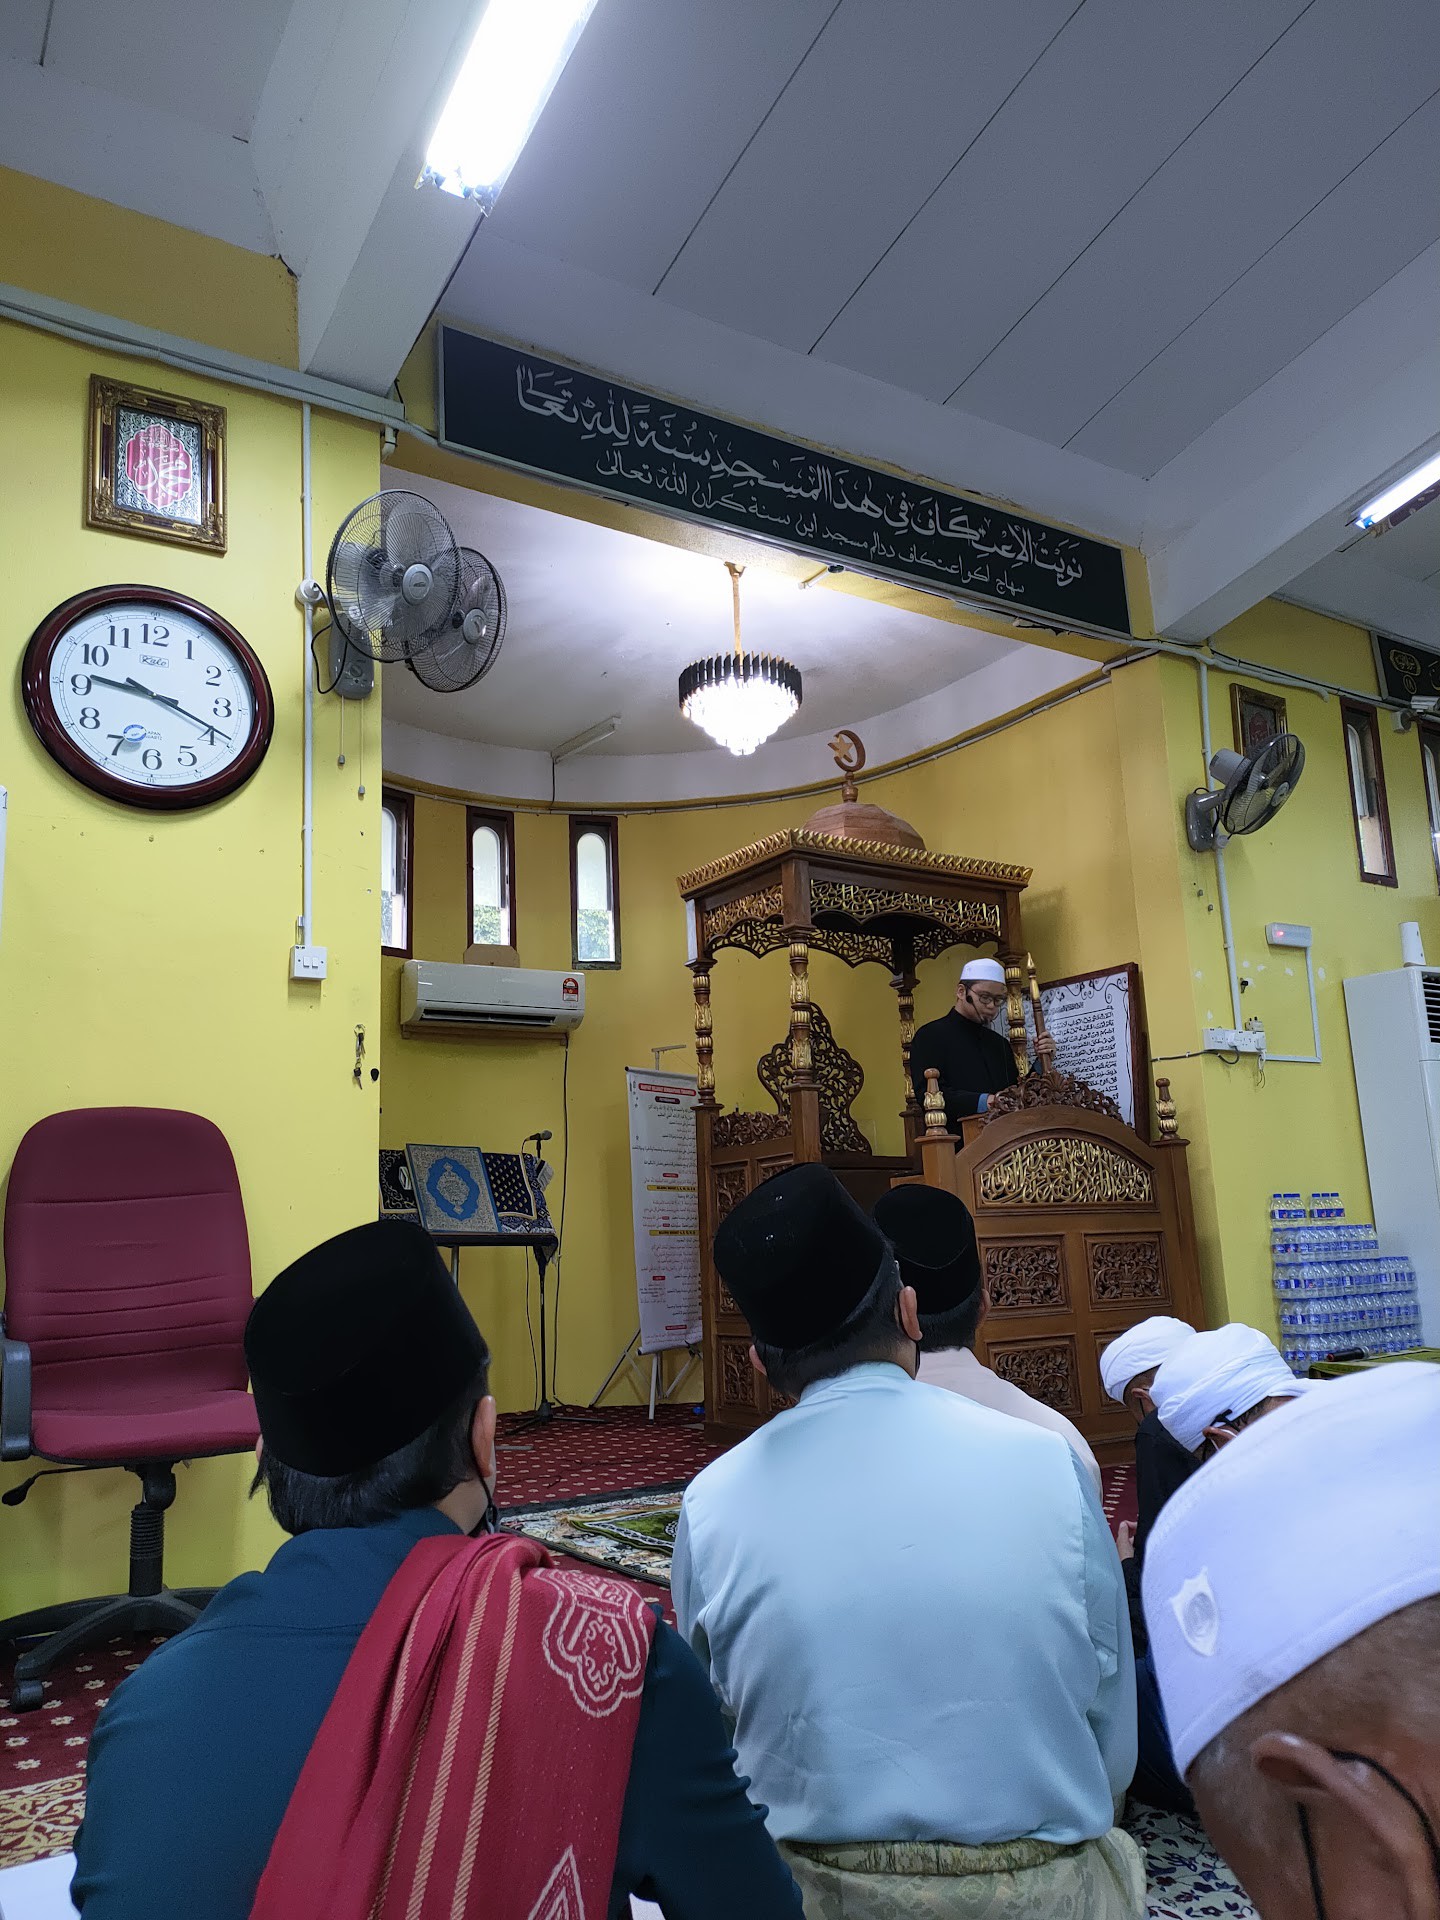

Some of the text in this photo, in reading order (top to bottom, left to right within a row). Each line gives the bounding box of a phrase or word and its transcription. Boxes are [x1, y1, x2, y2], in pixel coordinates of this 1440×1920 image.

[821, 526, 868, 549] مسجد
[106, 625, 132, 650] 11
[139, 623, 170, 648] 12
[80, 643, 110, 668] 10
[184, 639, 195, 661] 1
[70, 673, 92, 696] 9
[205, 665, 222, 687] 2
[79, 706, 101, 730] 8
[213, 697, 232, 718] 3
[106, 733, 126, 757] 7
[197, 725, 217, 747] 4
[142, 748, 163, 771] 6
[177, 745, 198, 767] 5
